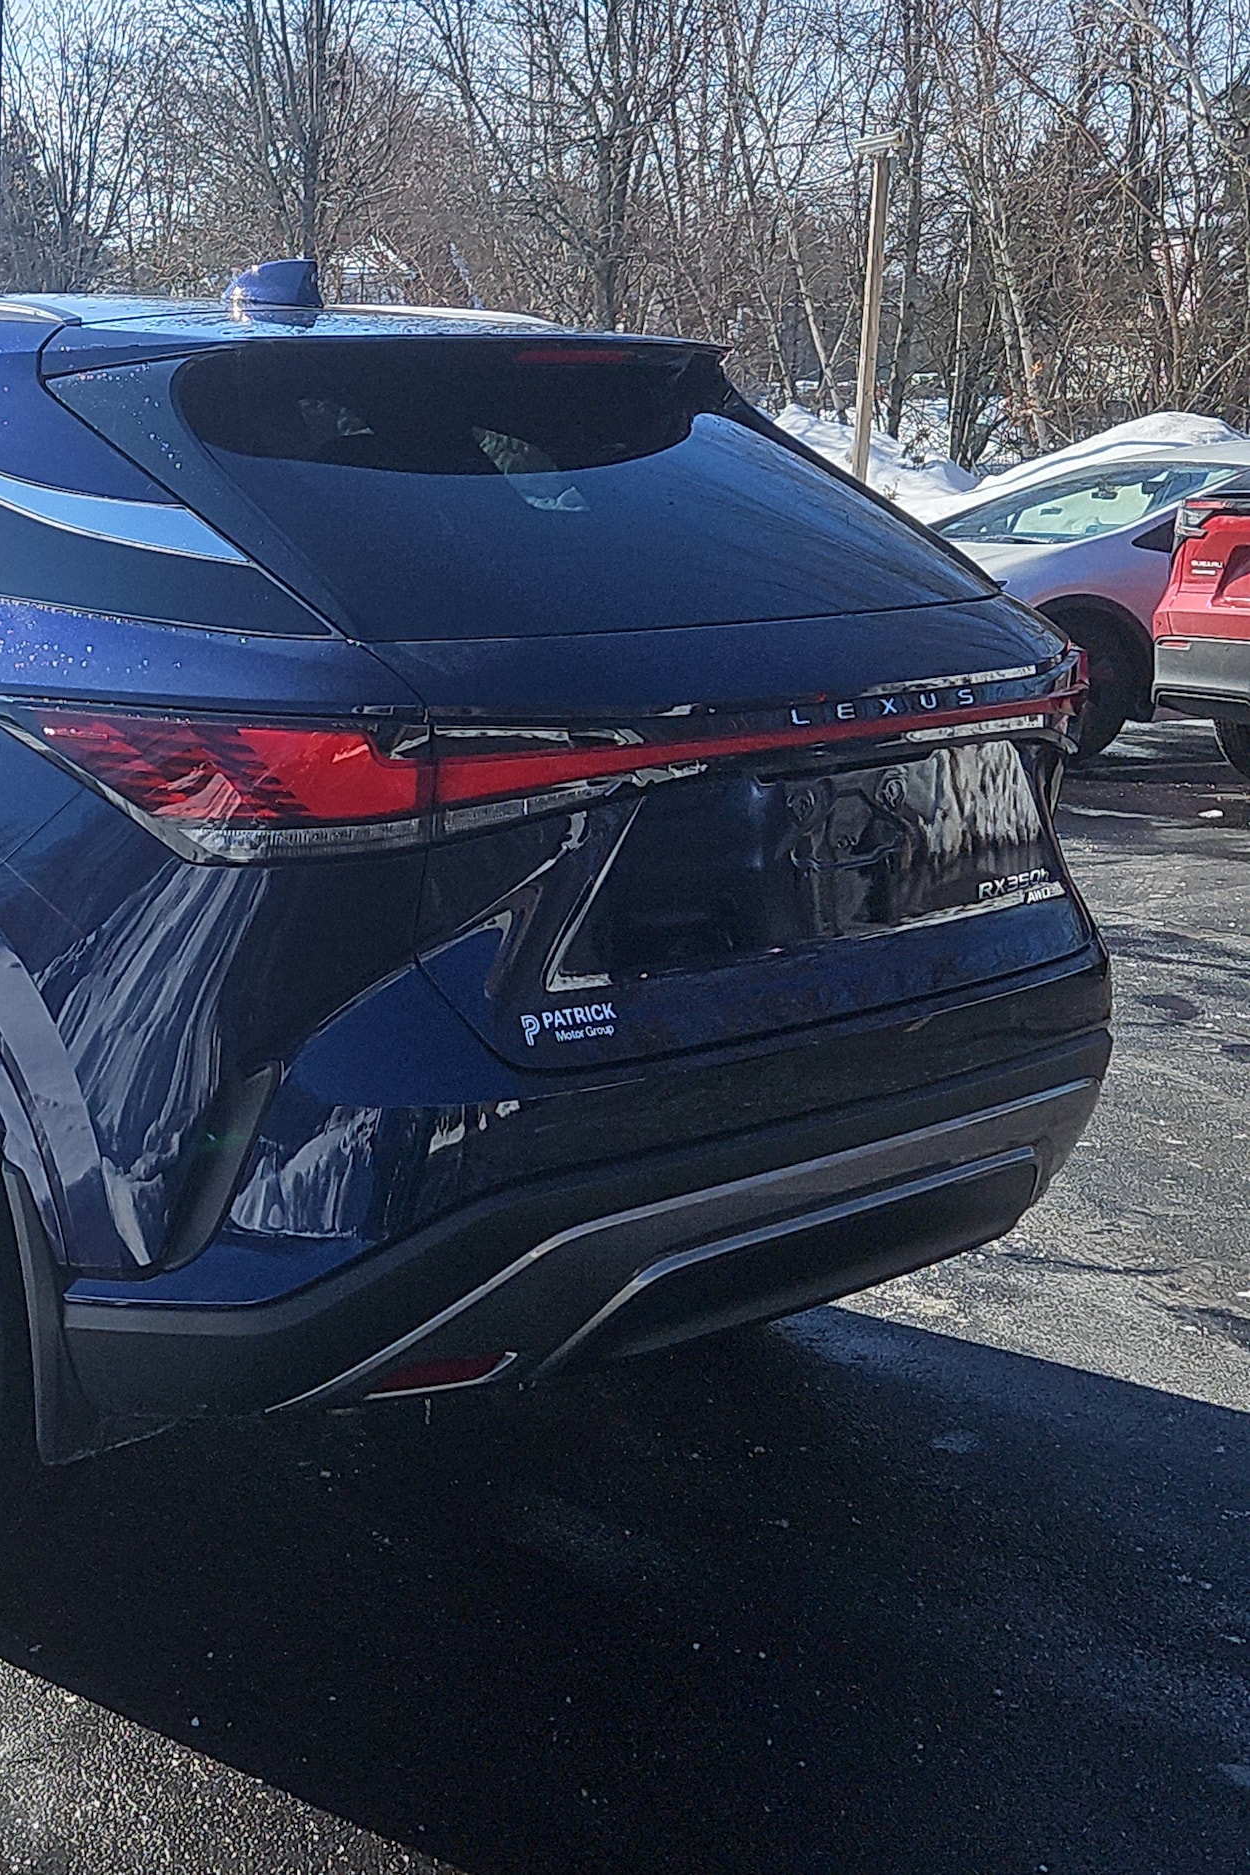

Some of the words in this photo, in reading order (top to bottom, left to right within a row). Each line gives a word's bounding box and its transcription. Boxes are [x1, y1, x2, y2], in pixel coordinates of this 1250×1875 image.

[790, 688, 975, 726] LEXUS
[978, 867, 1050, 899] RX350h
[1026, 886, 1051, 904] AWD
[541, 1002, 618, 1029] PATRICK
[555, 1028, 585, 1042] Motor
[585, 1024, 615, 1038] Group
